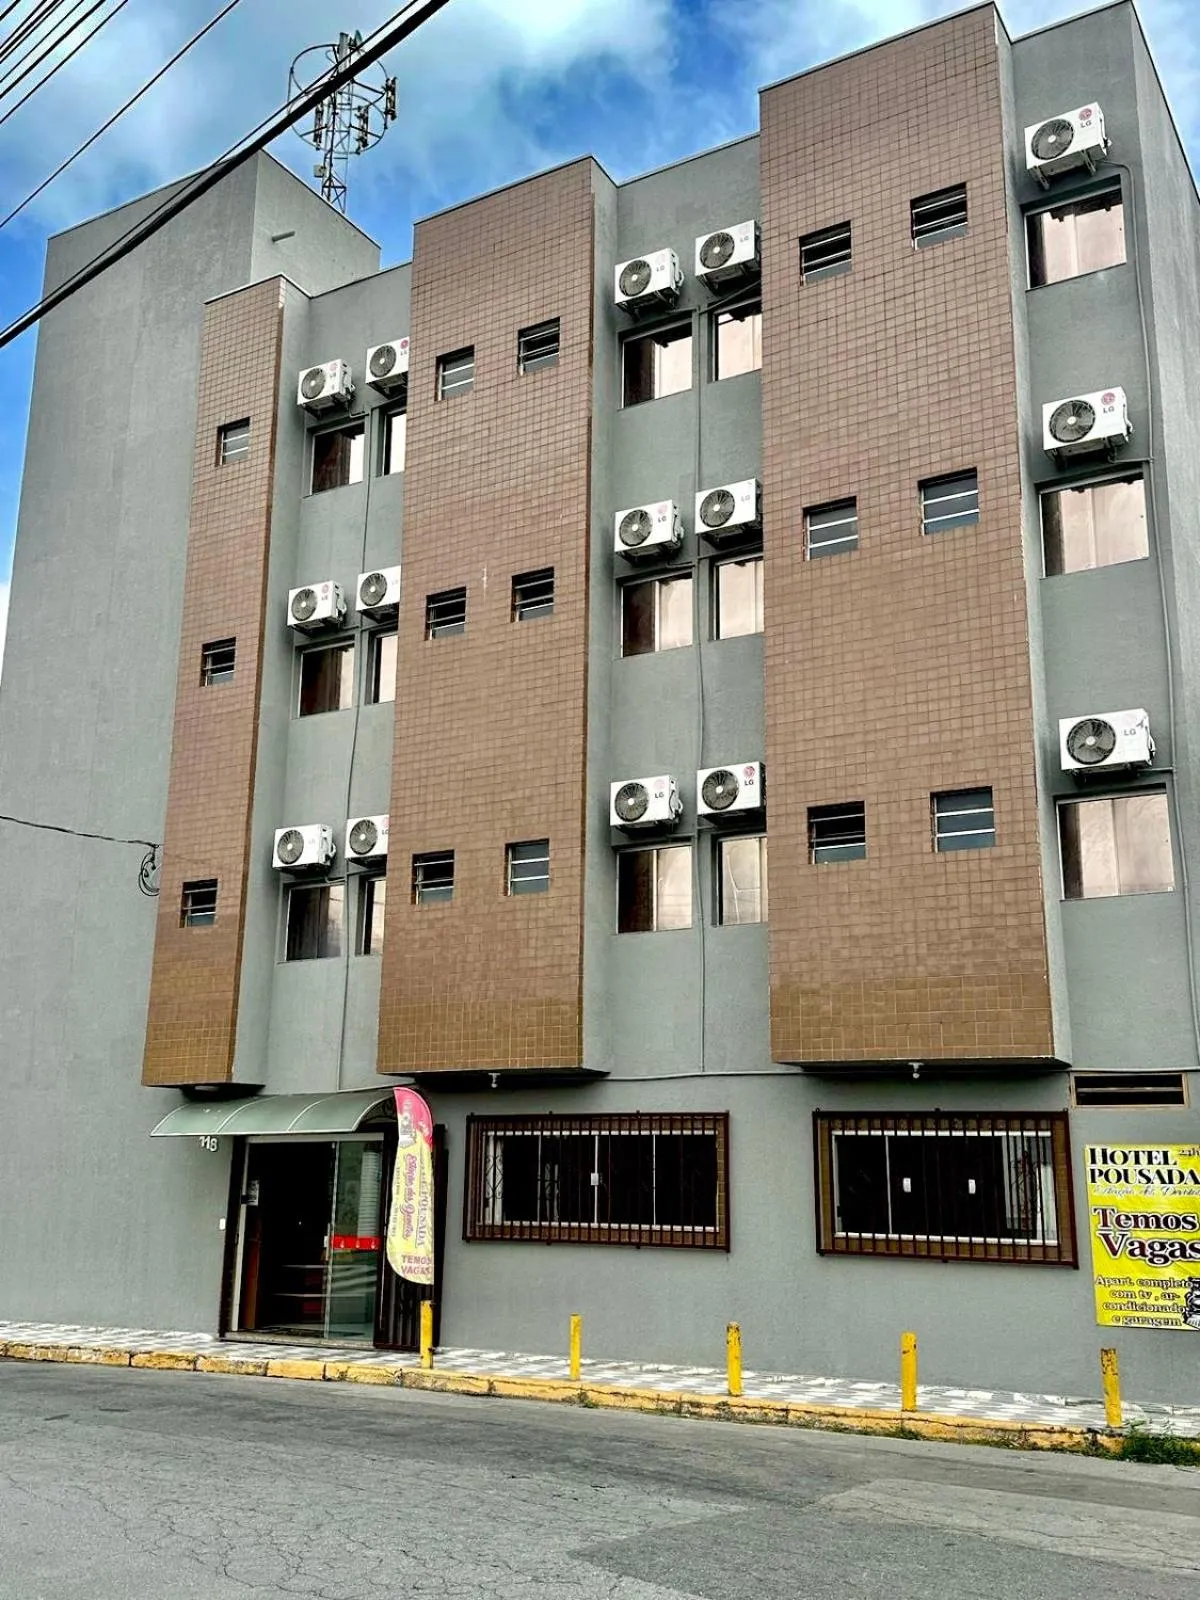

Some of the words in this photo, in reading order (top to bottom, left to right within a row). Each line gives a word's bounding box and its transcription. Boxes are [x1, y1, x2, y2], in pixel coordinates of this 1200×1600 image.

[1080, 120, 1092, 128] LG
[1103, 405, 1115, 414] LG
[1123, 728, 1137, 736] LG
[654, 791, 665, 799] LG
[1089, 1148, 1177, 1165] HOTEL
[1089, 1168, 1200, 1184] POUSADA
[1093, 1207, 1198, 1230] Temos
[1097, 1232, 1200, 1266] Vagas
[1095, 1275, 1135, 1288] Apart.
[1110, 1290, 1136, 1299] com
[1103, 1301, 1186, 1313] condicionado
[1122, 1315, 1182, 1327] garagem
